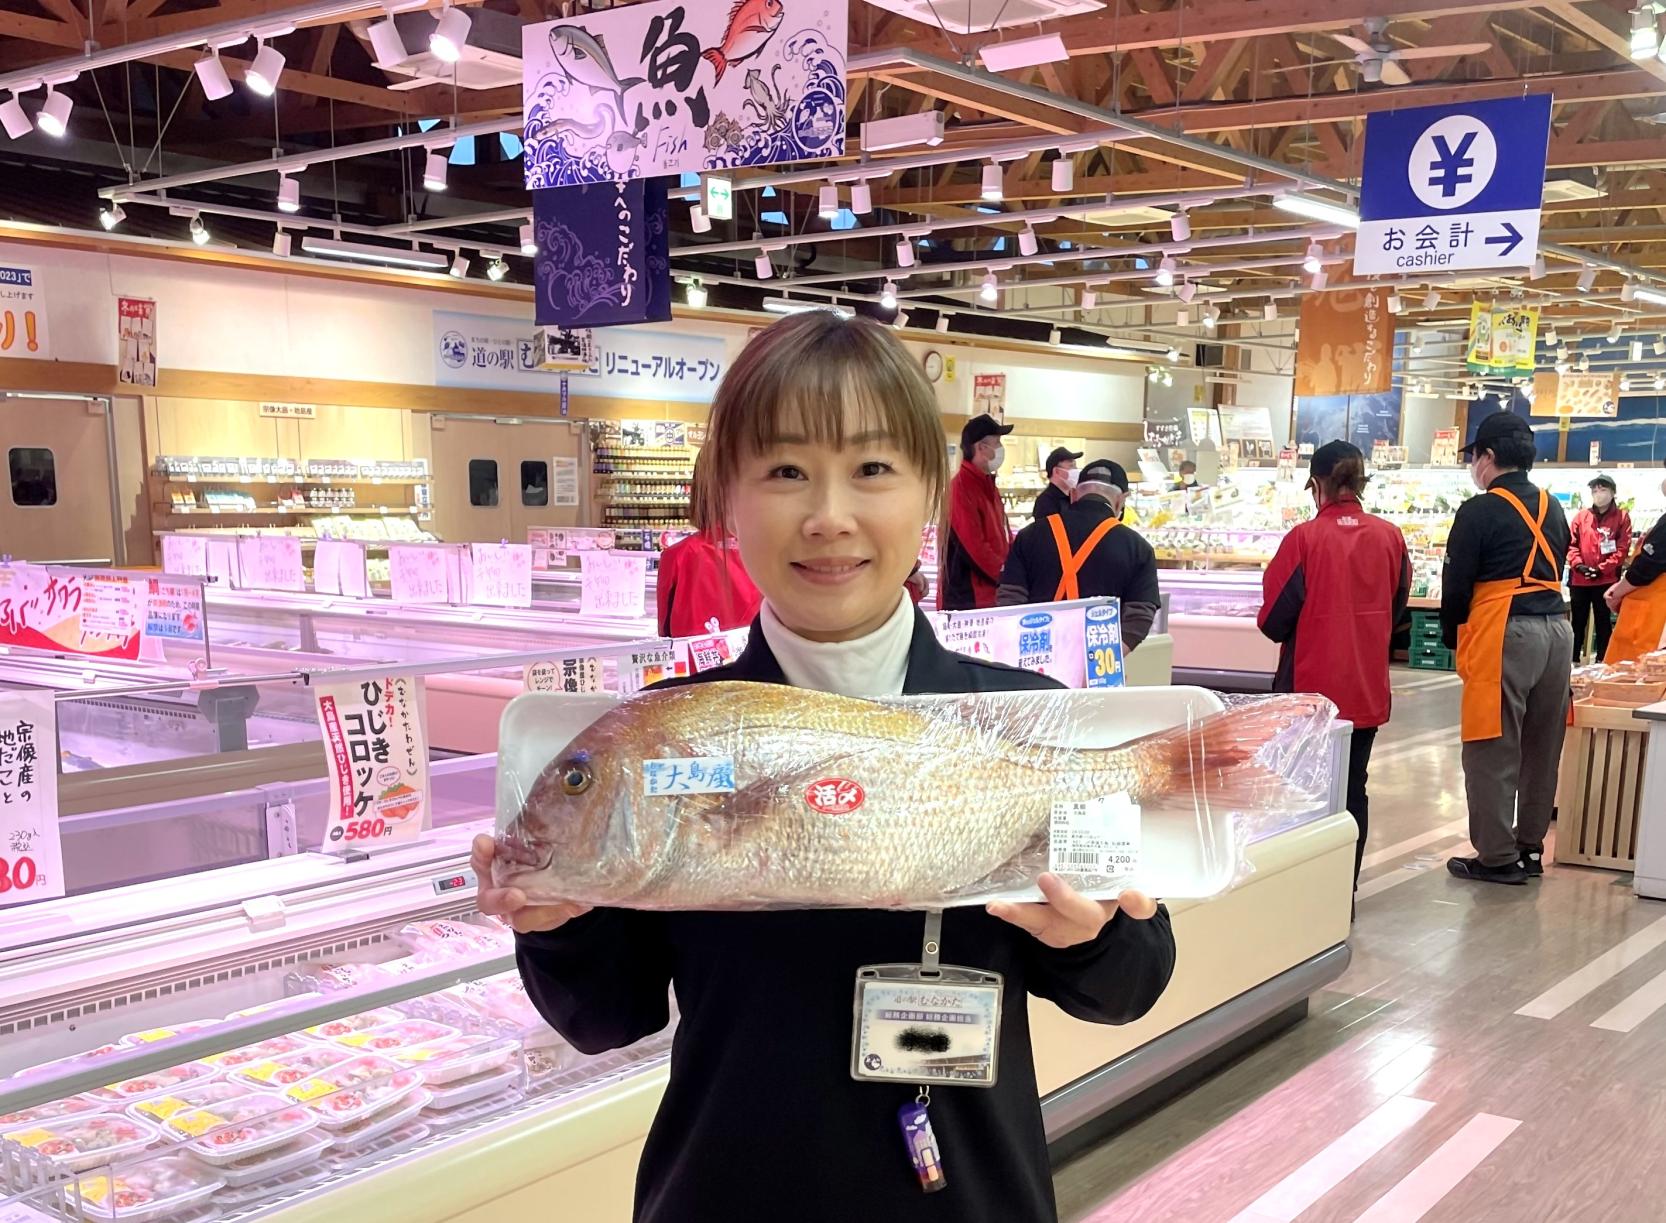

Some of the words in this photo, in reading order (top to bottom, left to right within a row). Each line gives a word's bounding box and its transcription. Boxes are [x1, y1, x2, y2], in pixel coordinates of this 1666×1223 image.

[634, 6, 711, 130] 魚
[653, 127, 688, 162] Fish
[1383, 222, 1474, 250] お会計
[1396, 250, 1455, 267] cashier
[472, 346, 514, 370] 道の駅
[606, 351, 720, 381] リニューアルオープン
[360, 680, 390, 763] ひじき
[16, 720, 37, 802] 宗像産の
[344, 713, 373, 817] コロッケ
